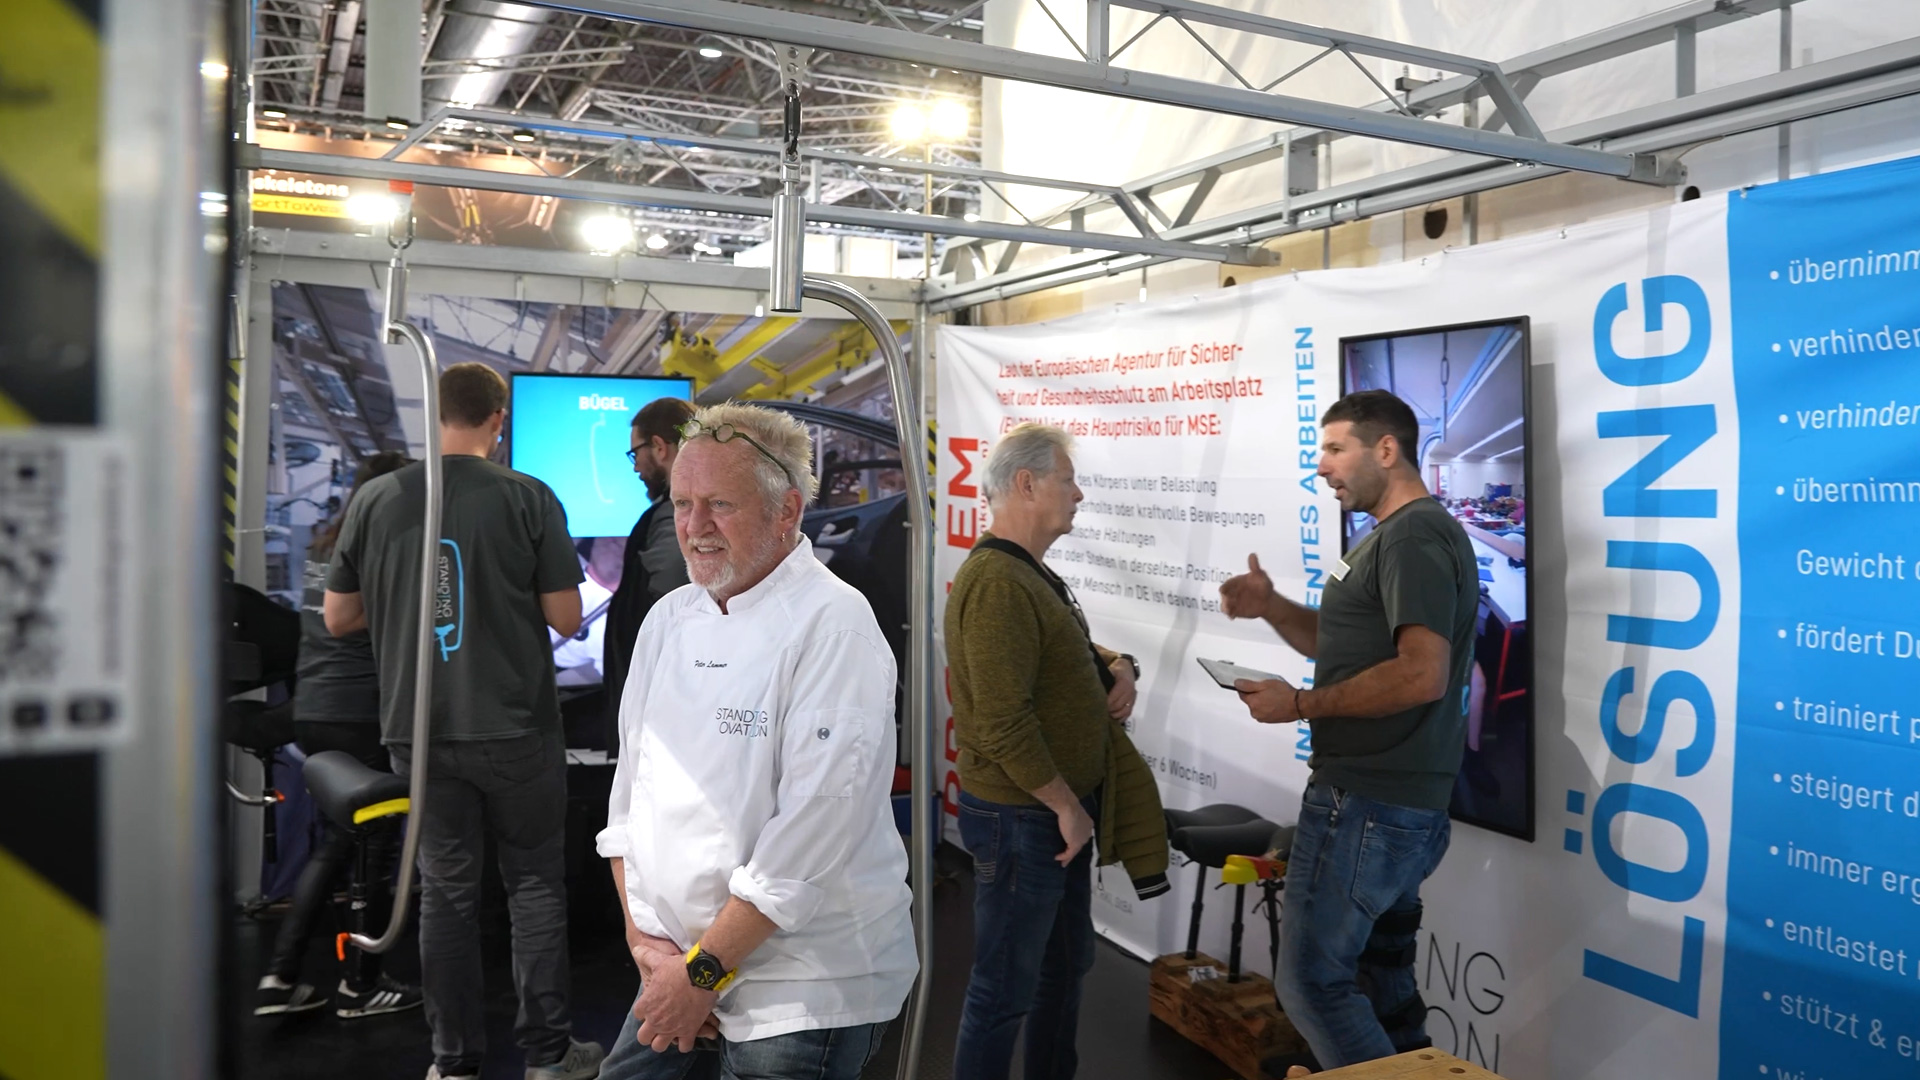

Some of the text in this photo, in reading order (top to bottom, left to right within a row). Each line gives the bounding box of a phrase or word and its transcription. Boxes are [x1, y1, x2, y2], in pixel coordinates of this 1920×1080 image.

[1112, 351, 1164, 375] Agentur
[1166, 346, 1187, 367] für
[1189, 341, 1243, 365] Sicher-
[578, 393, 629, 410] BÜGEL
[1017, 388, 1039, 406] und
[1147, 387, 1169, 402] am
[1171, 376, 1263, 402] Arbeitsplatz
[1067, 417, 1089, 436] das
[1091, 415, 1162, 441] Hauptrisiko
[1165, 415, 1184, 436] für
[1187, 413, 1221, 436] MSE:
[1294, 326, 1319, 495] ARBEITEN
[1130, 477, 1158, 491] unter
[1160, 476, 1217, 496] Belastung
[1136, 503, 1187, 522] kraftvolle
[1189, 506, 1266, 529] Bewegungen
[1103, 527, 1156, 548] Haltungen
[1130, 558, 1183, 580] derselben
[1796, 549, 1905, 580] Gewicht
[1083, 576, 1122, 596] Mensch
[1123, 582, 1134, 598] in
[1135, 584, 1151, 602] DE
[1563, 274, 1721, 1020] LÖSUNG
[1796, 622, 1886, 657] fördert
[1793, 696, 1901, 737] trainiert
[1160, 756, 1167, 773] 6
[1169, 758, 1218, 791] Wochen)
[1790, 772, 1895, 814] steigert
[1787, 841, 1874, 886] immer
[1783, 920, 1908, 976] entlastet
[1779, 994, 1860, 1040] stützt
[1867, 1018, 1887, 1049] &
